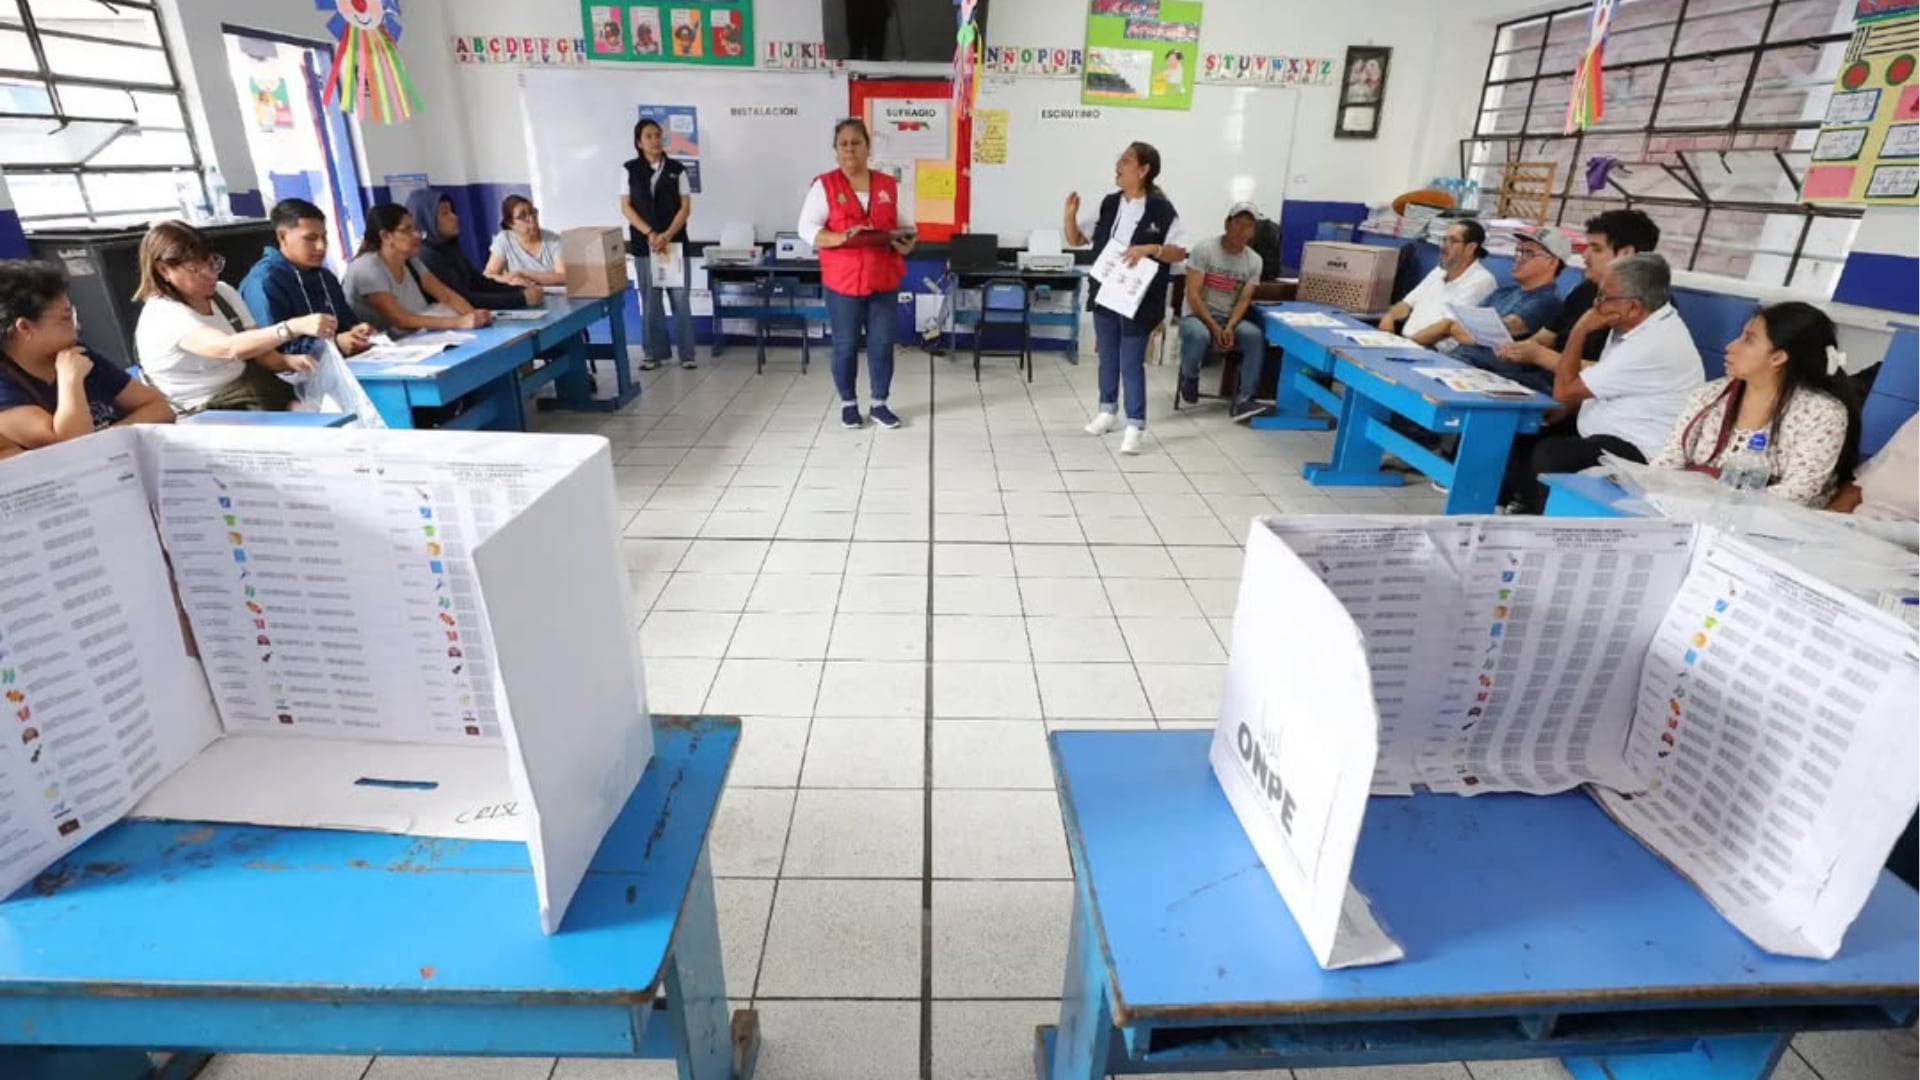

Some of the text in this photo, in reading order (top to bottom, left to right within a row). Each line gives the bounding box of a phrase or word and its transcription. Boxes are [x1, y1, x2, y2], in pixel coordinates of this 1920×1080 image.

[886, 108, 937, 118] SUFRAGIO
[1041, 108, 1101, 120] ESCRUTINIO
[1237, 721, 1297, 837] ONPE
